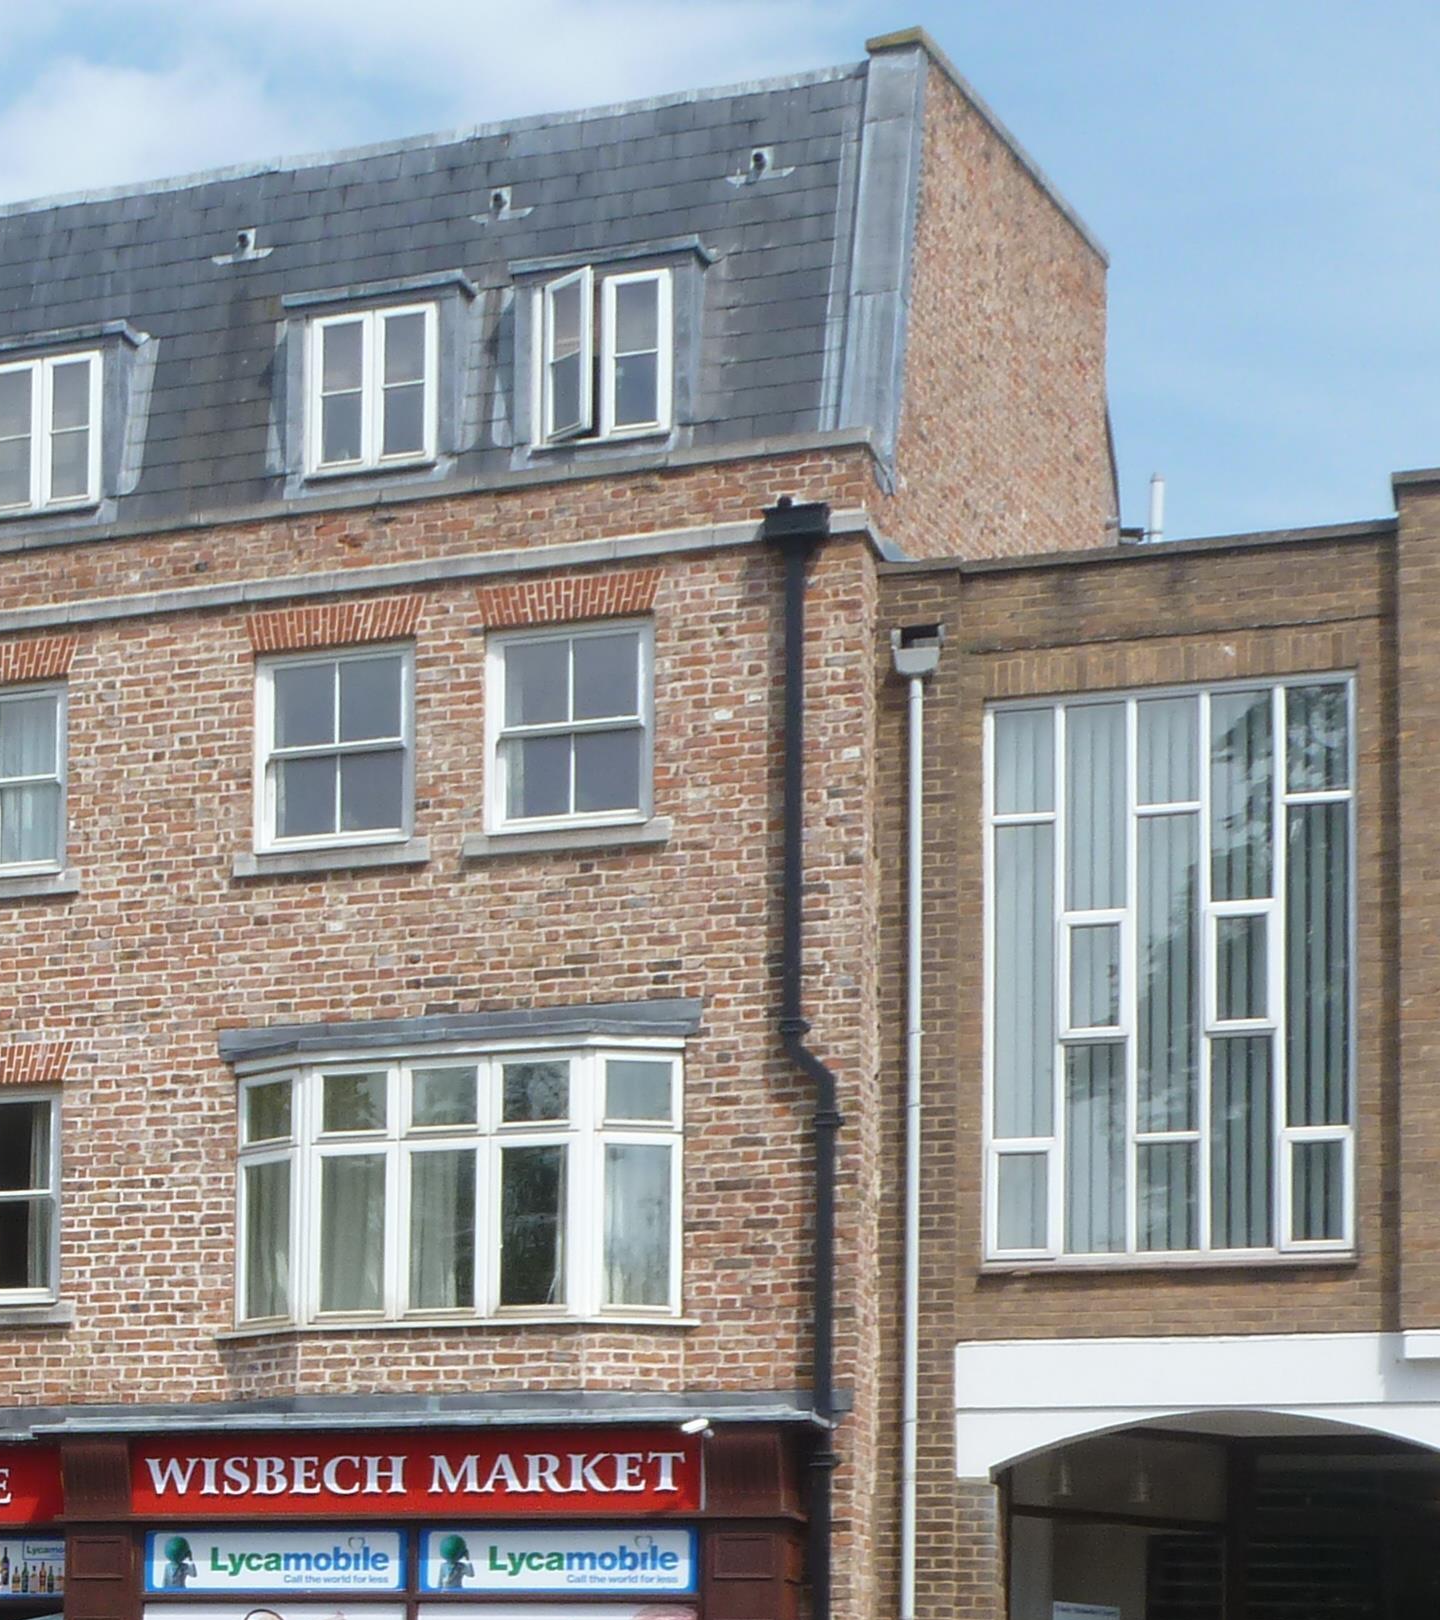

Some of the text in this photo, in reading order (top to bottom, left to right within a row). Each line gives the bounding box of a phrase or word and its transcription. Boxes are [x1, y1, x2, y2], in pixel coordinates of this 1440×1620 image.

[145, 1451, 686, 1496] WISBECH MARKET
[210, 1547, 389, 1577] Lycamobile
[489, 1545, 679, 1576] Lycamobile
[283, 1574, 389, 1584] Call the world for less
[566, 1574, 679, 1584] Call the world for less
